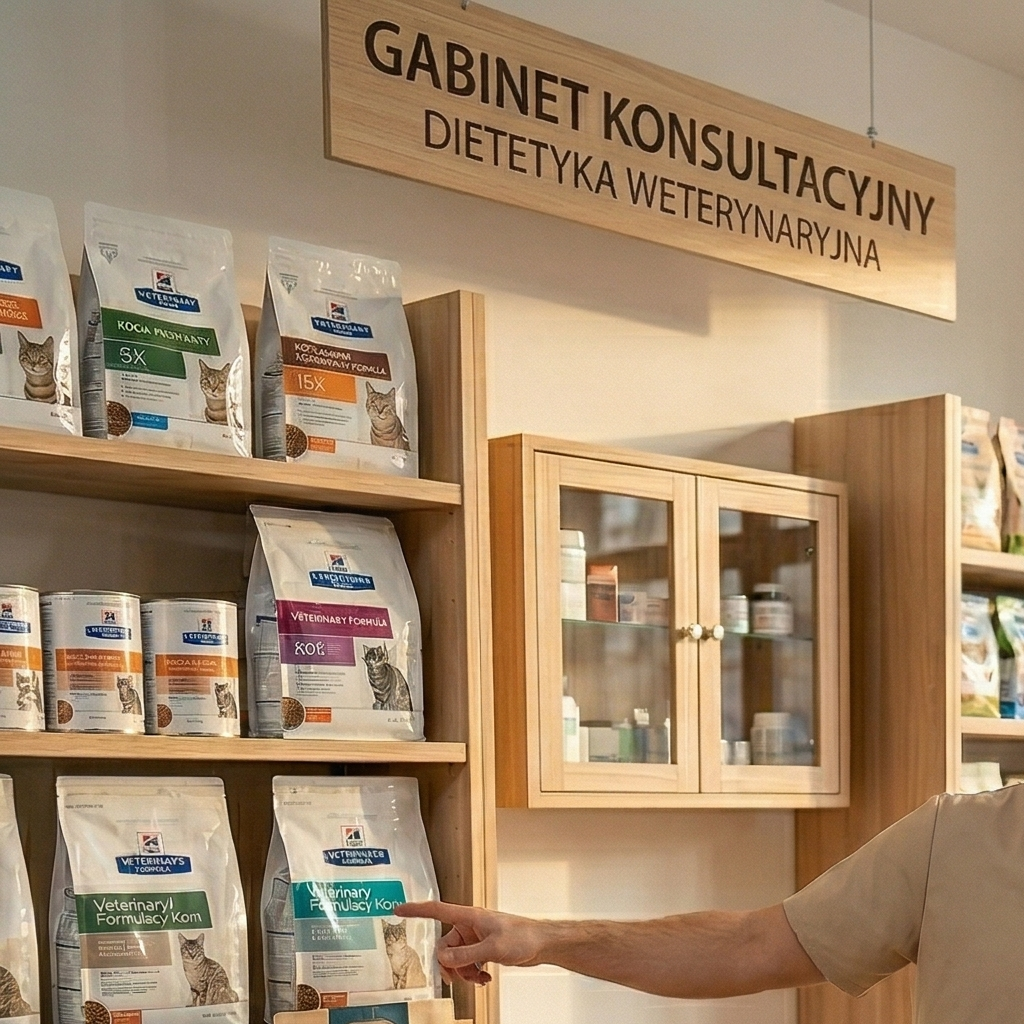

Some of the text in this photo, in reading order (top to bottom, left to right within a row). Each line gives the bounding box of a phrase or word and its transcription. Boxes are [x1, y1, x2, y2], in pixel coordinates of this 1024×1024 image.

[363, 19, 936, 236] GABINET KONSULTACYJNY
[423, 109, 882, 272] DIETETYKA WETERYNARYJNA
